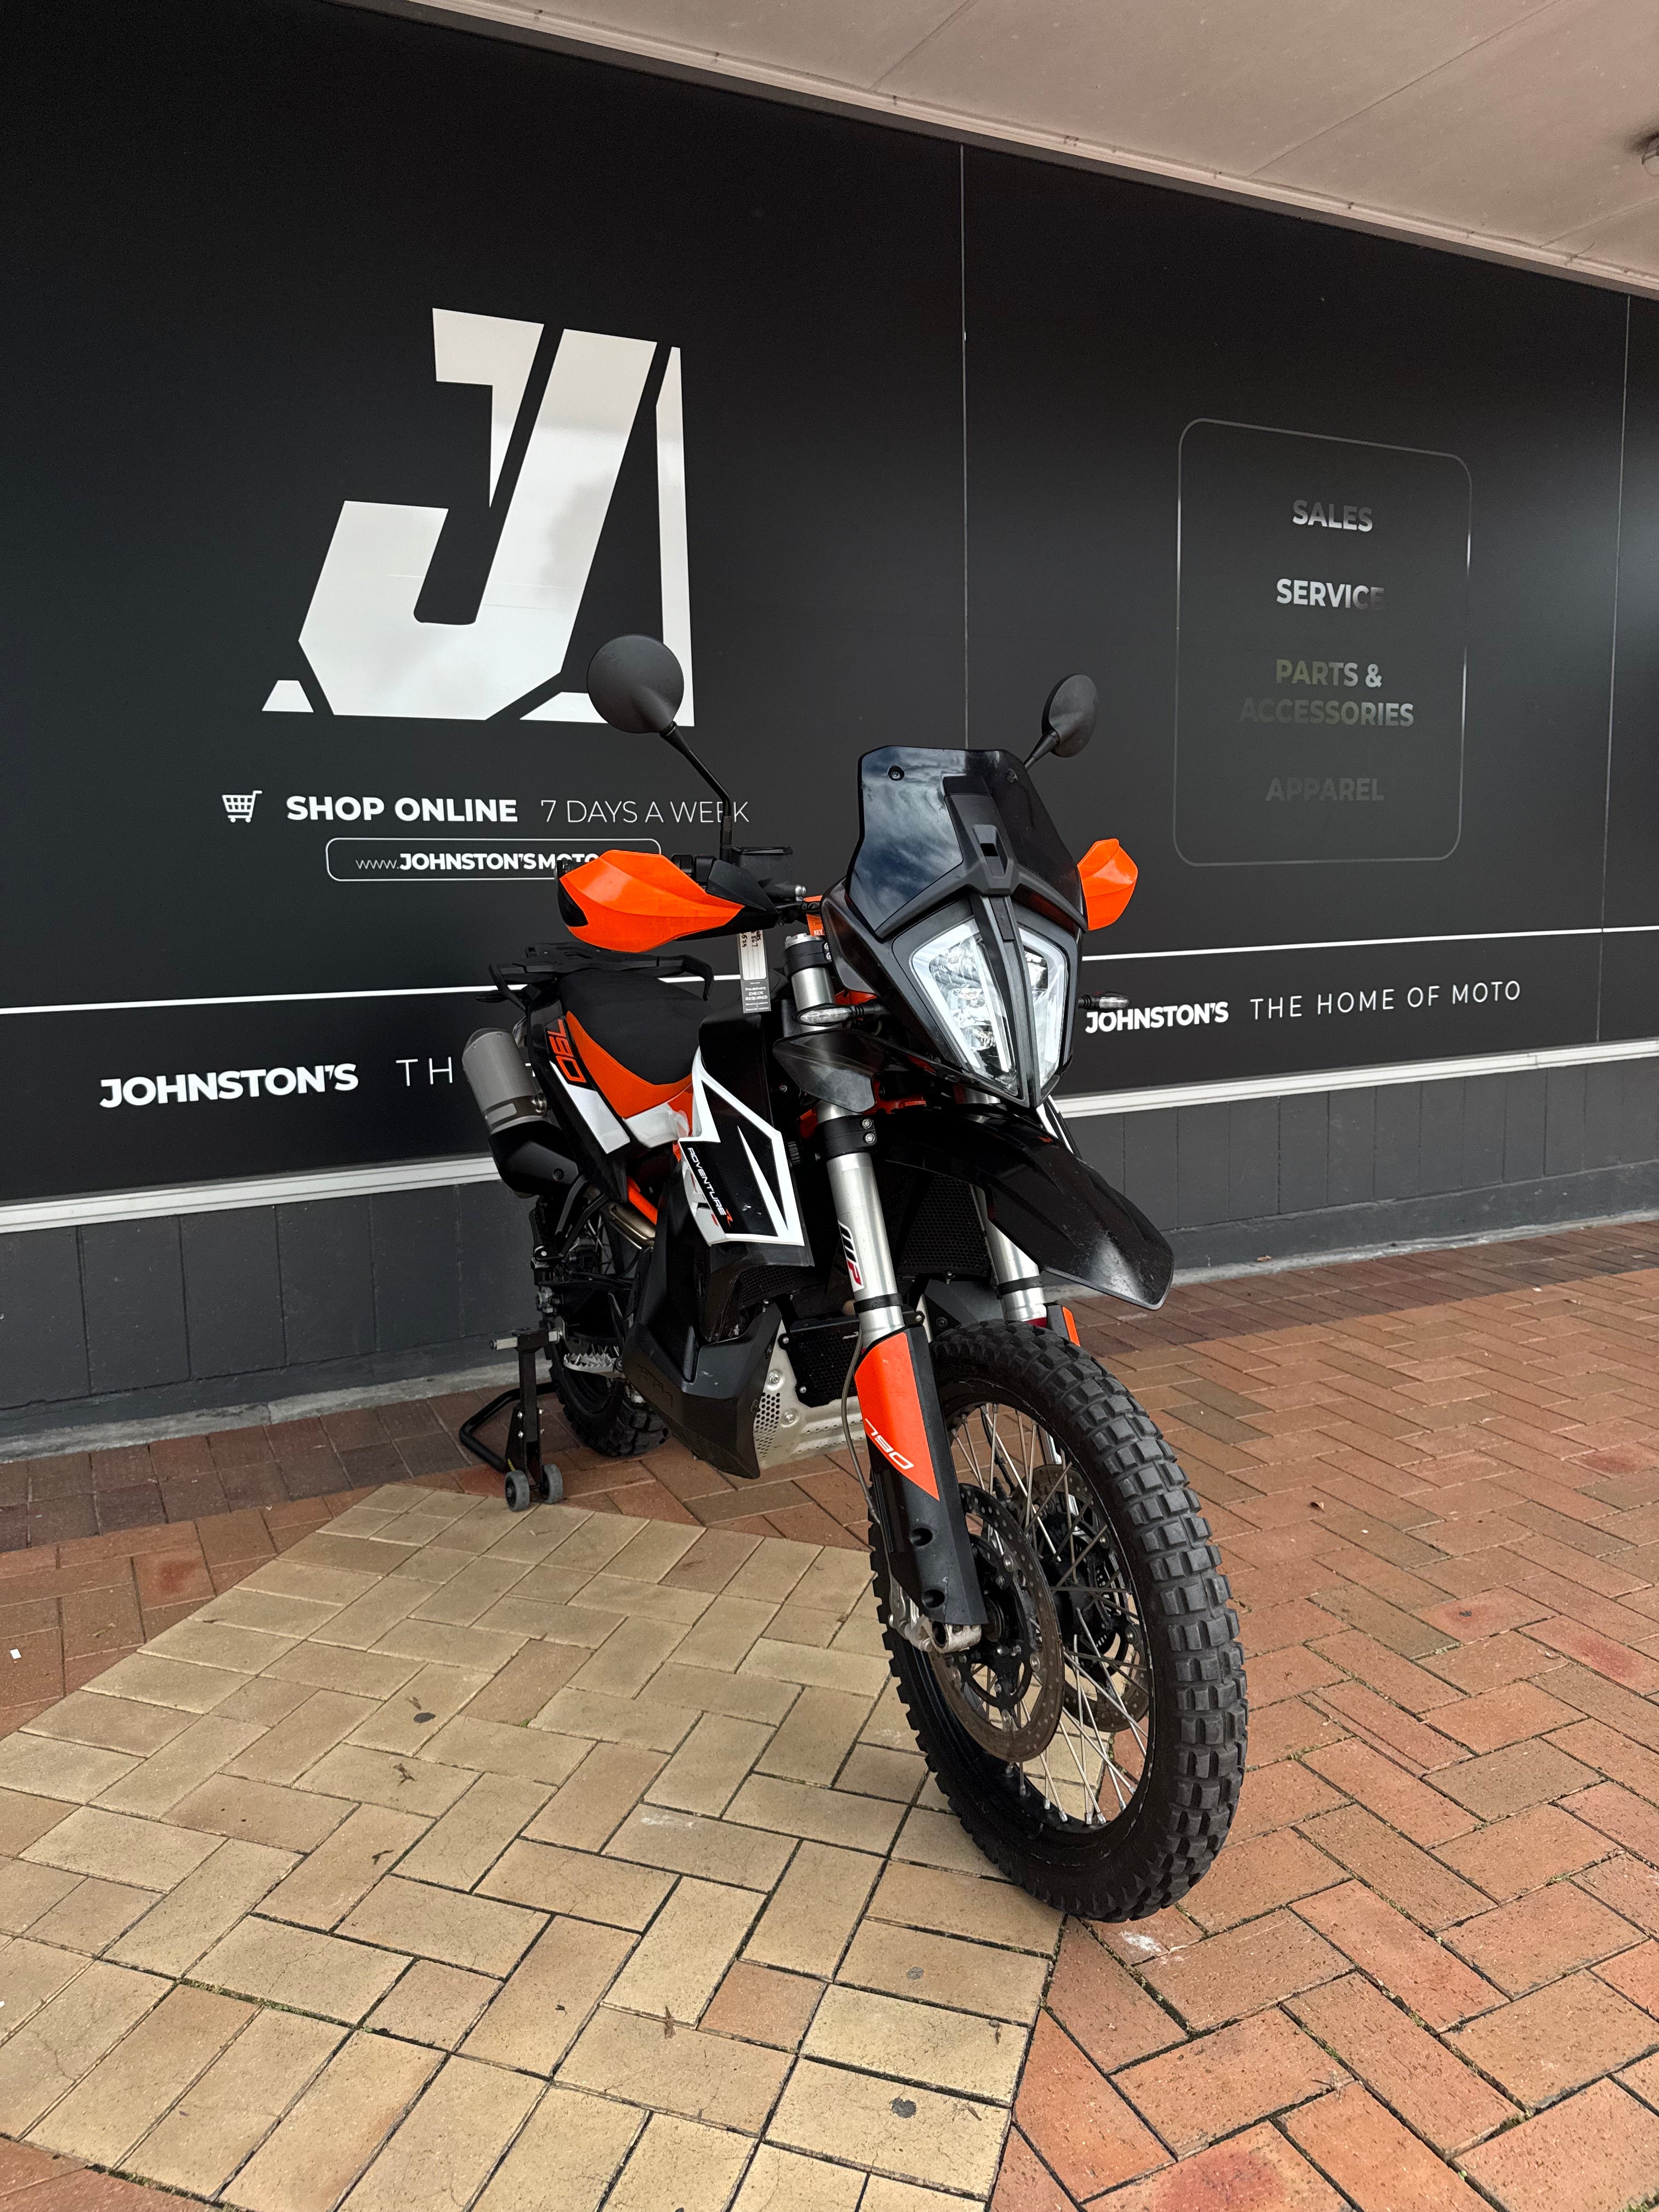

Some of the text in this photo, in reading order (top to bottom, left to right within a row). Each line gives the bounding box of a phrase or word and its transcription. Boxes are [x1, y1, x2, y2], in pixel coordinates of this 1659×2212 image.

[1292, 499, 1373, 533] SALES
[1276, 578, 1385, 610] SERVICE
[1276, 659, 1383, 689] PARTS &
[1239, 697, 1415, 727] ACCESSORIES
[1265, 777, 1385, 802] APPAREL
[286, 795, 750, 823] SHOP ONLINE 7 DAYS A WEEK
[1085, 980, 1521, 1034] JOHNSTON'S THE HOME OF MOTO
[546, 1019, 587, 1083] 790
[99, 1057, 453, 1108] JOHNSTON'S TH
[687, 1147, 727, 1216] ADVENTURE
[865, 1418, 915, 1470] 790
